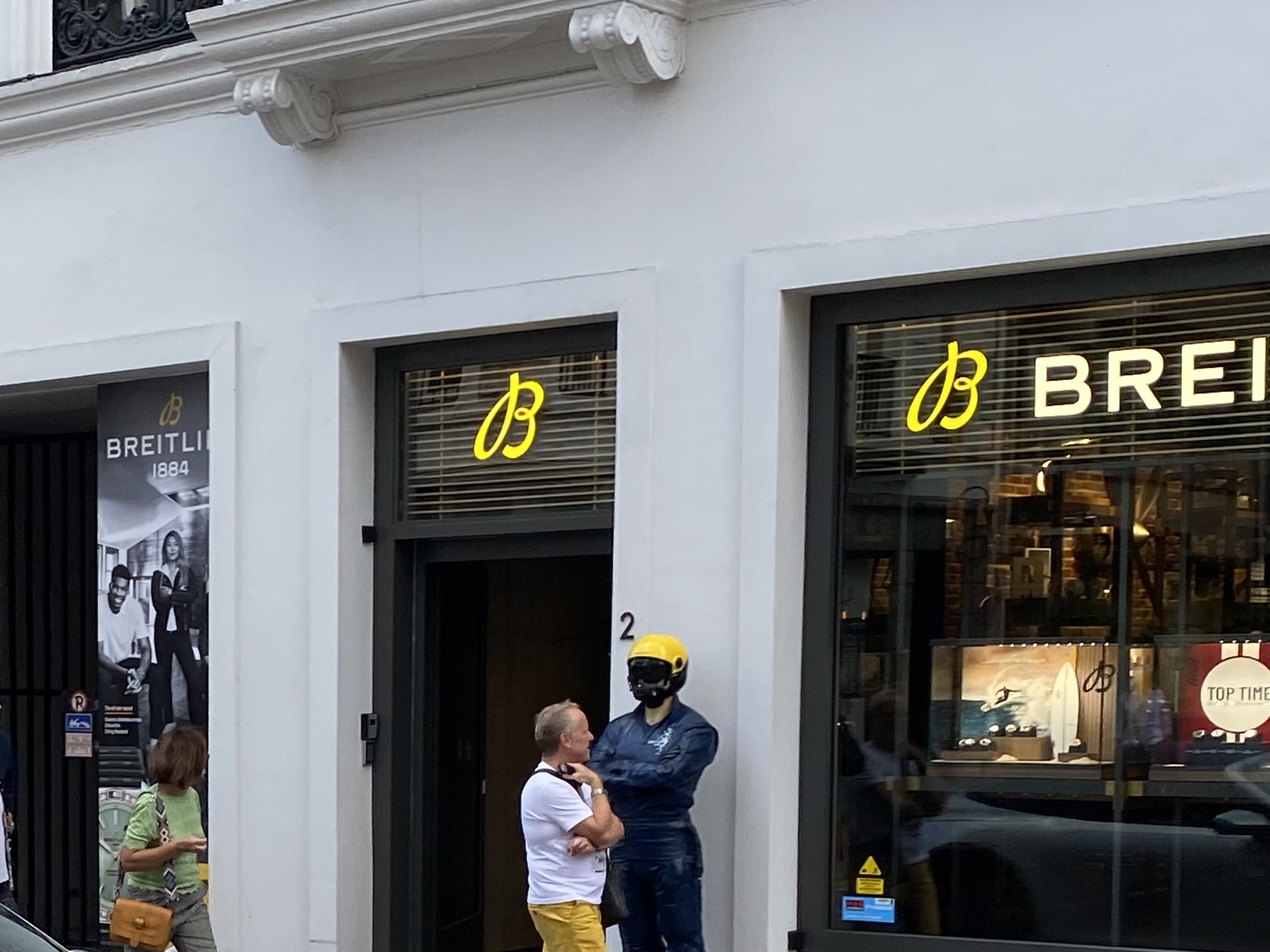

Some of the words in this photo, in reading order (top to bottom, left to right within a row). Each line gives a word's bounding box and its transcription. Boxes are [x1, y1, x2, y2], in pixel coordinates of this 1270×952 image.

[1034, 336, 1267, 418] BREI
[106, 429, 210, 459] BREITLI
[152, 460, 190, 479] 1884
[619, 611, 635, 641] 2
[1207, 686, 1235, 701] TOP
[1239, 686, 1270, 701] TIME
